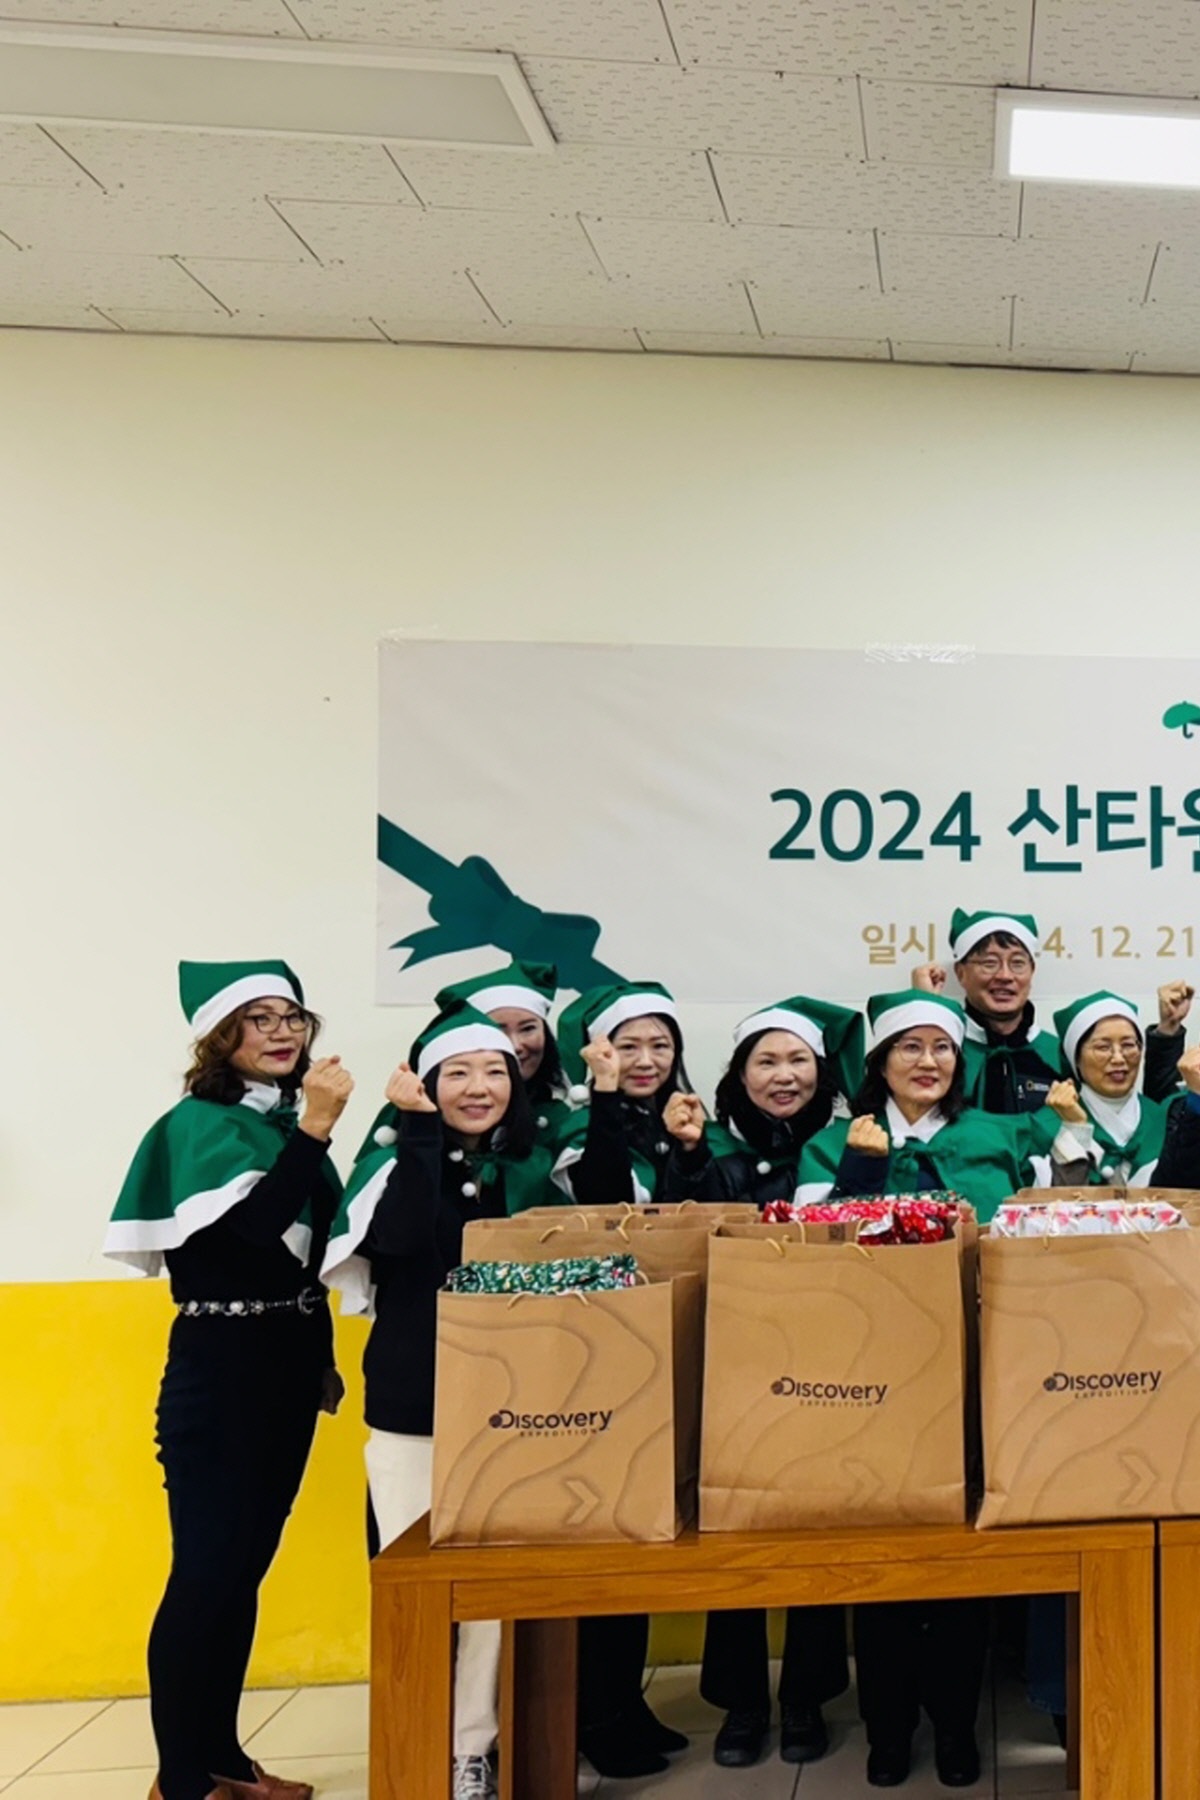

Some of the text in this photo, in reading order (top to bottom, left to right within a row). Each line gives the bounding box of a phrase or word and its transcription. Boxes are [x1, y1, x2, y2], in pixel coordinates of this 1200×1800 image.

[768, 787, 982, 863] 2024
[861, 922, 937, 966] 일시
[1091, 925, 1141, 959] 12.
